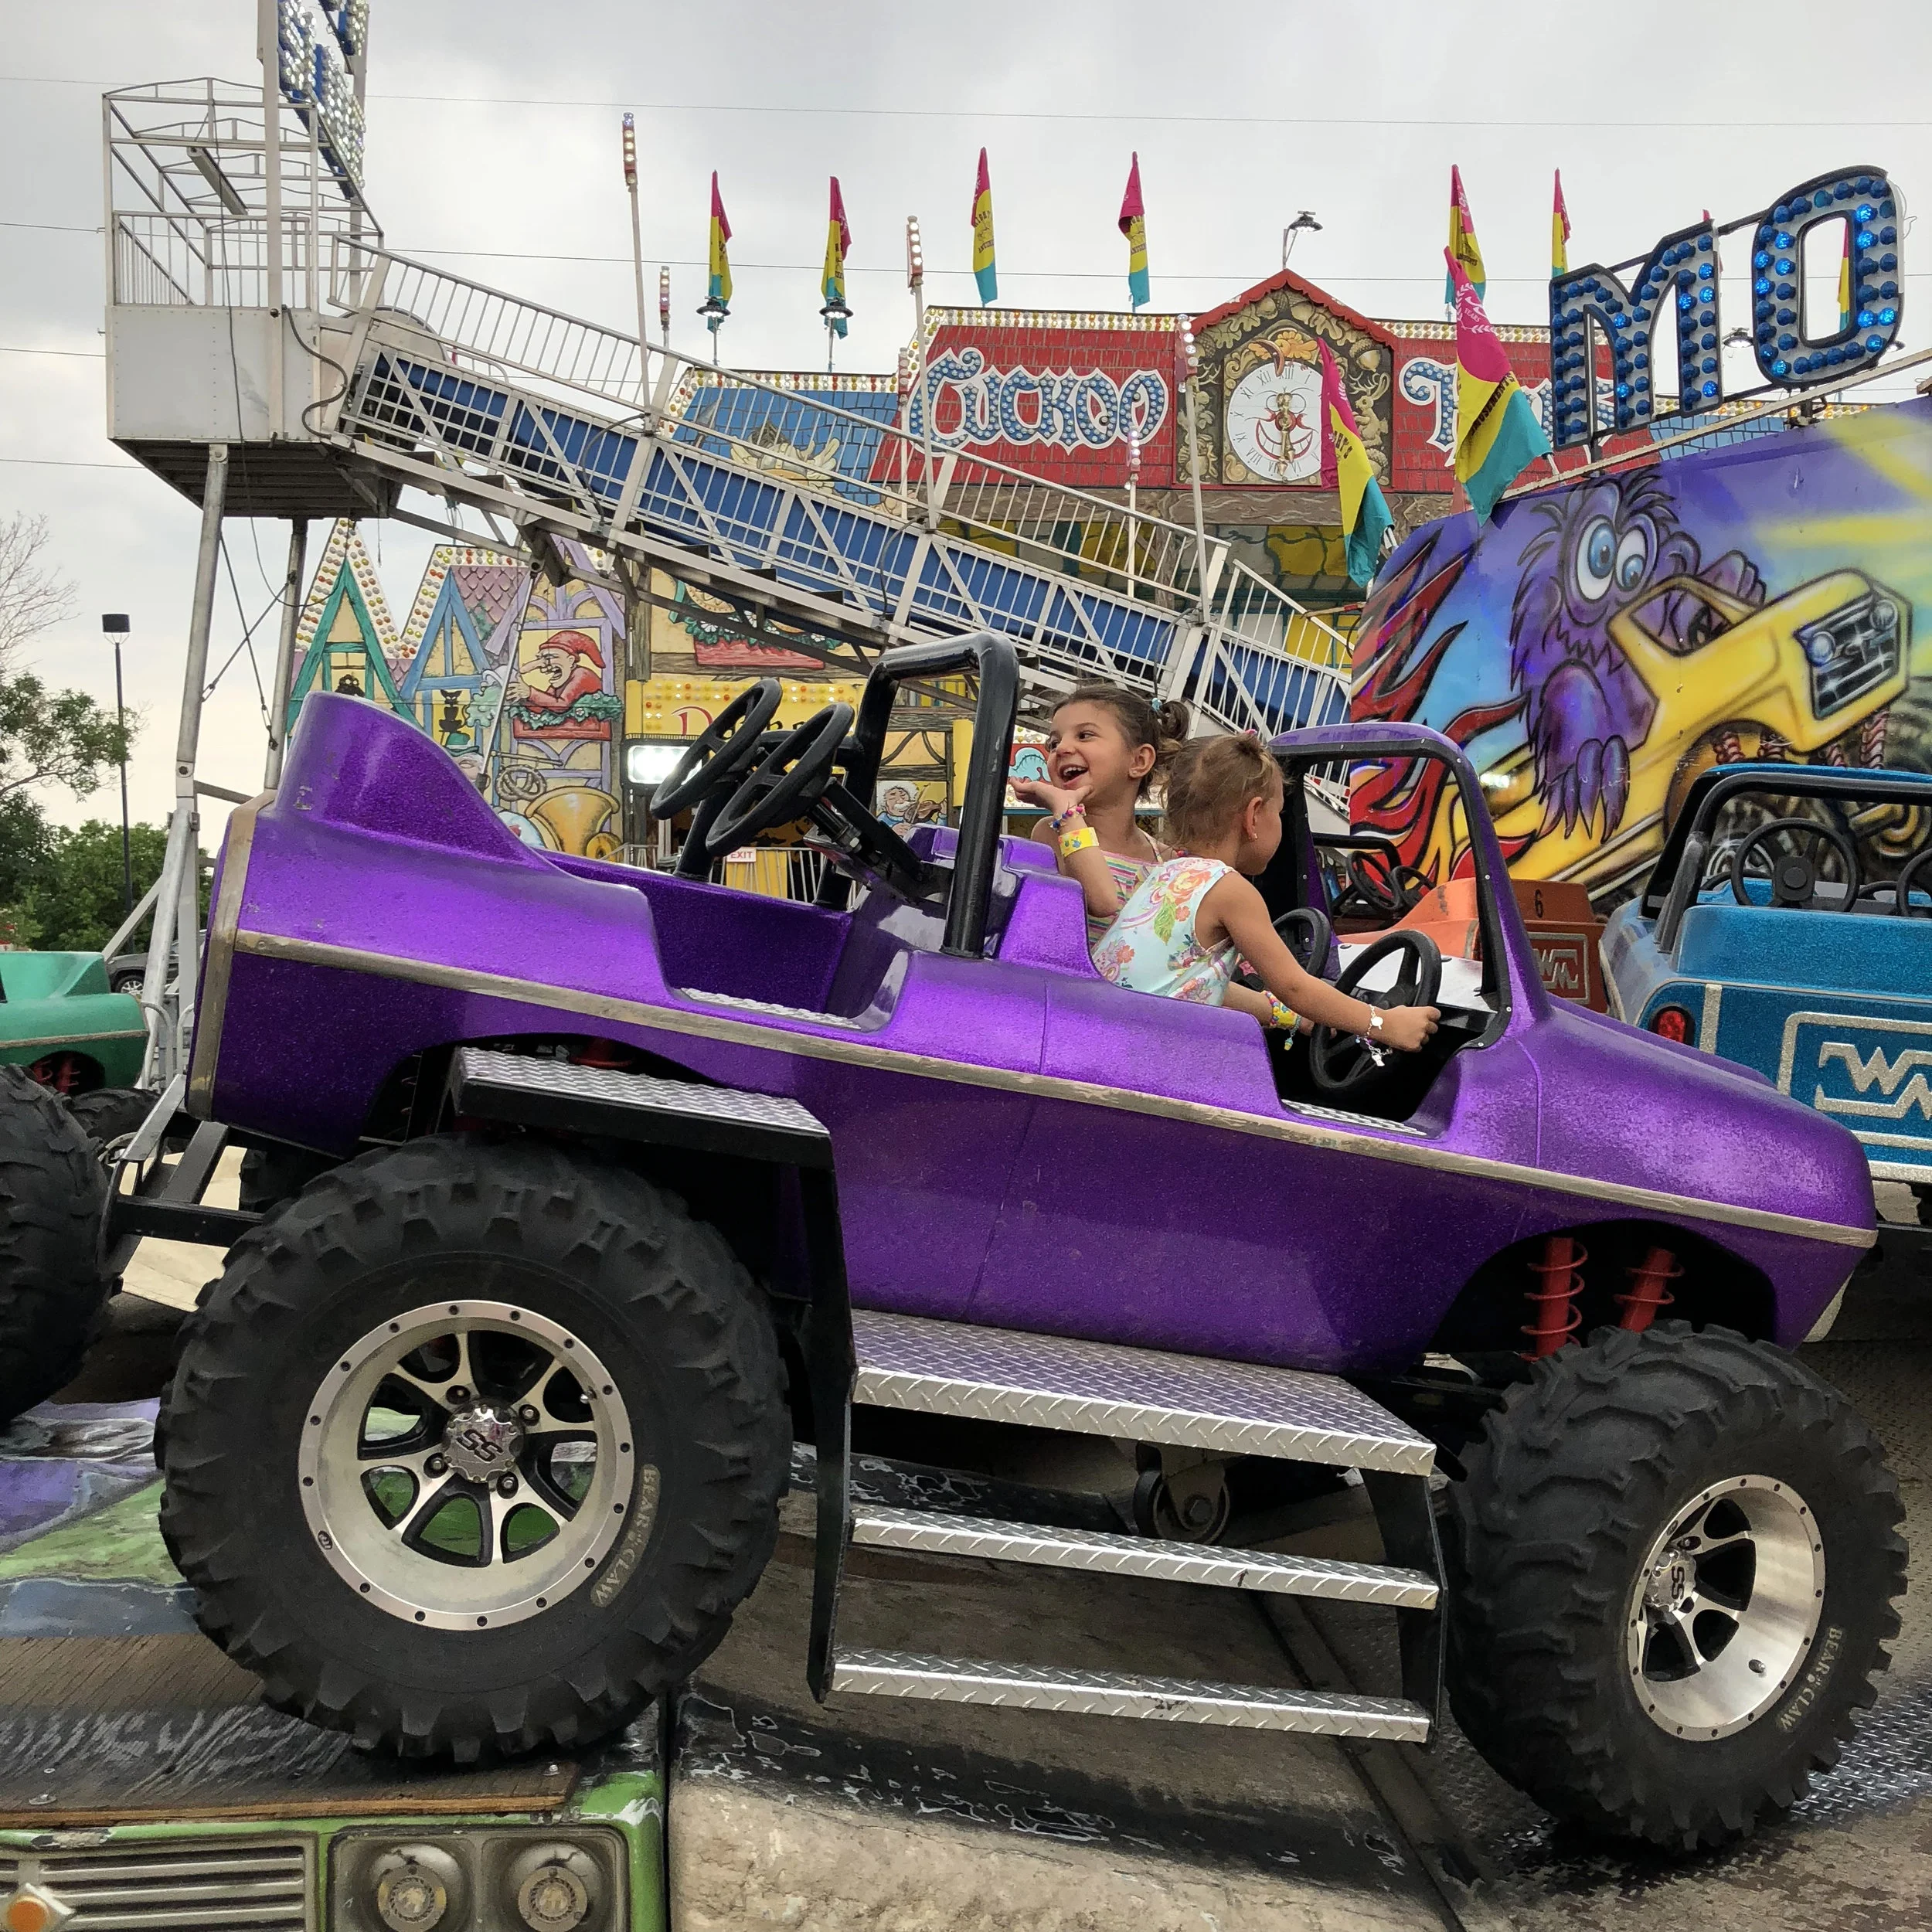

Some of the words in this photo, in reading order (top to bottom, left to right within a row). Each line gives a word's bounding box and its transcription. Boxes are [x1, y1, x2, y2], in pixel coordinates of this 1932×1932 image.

[1463, 307, 1481, 323] YEARS
[1534, 889, 1543, 918] 6
[455, 1429, 504, 1462] SS
[634, 1468, 657, 1528] BEAR
[595, 1548, 635, 1604] CLAW
[1671, 1566, 1685, 1600] SS
[1815, 1627, 1842, 1675] BEAR
[1780, 1687, 1815, 1730] CLAW
